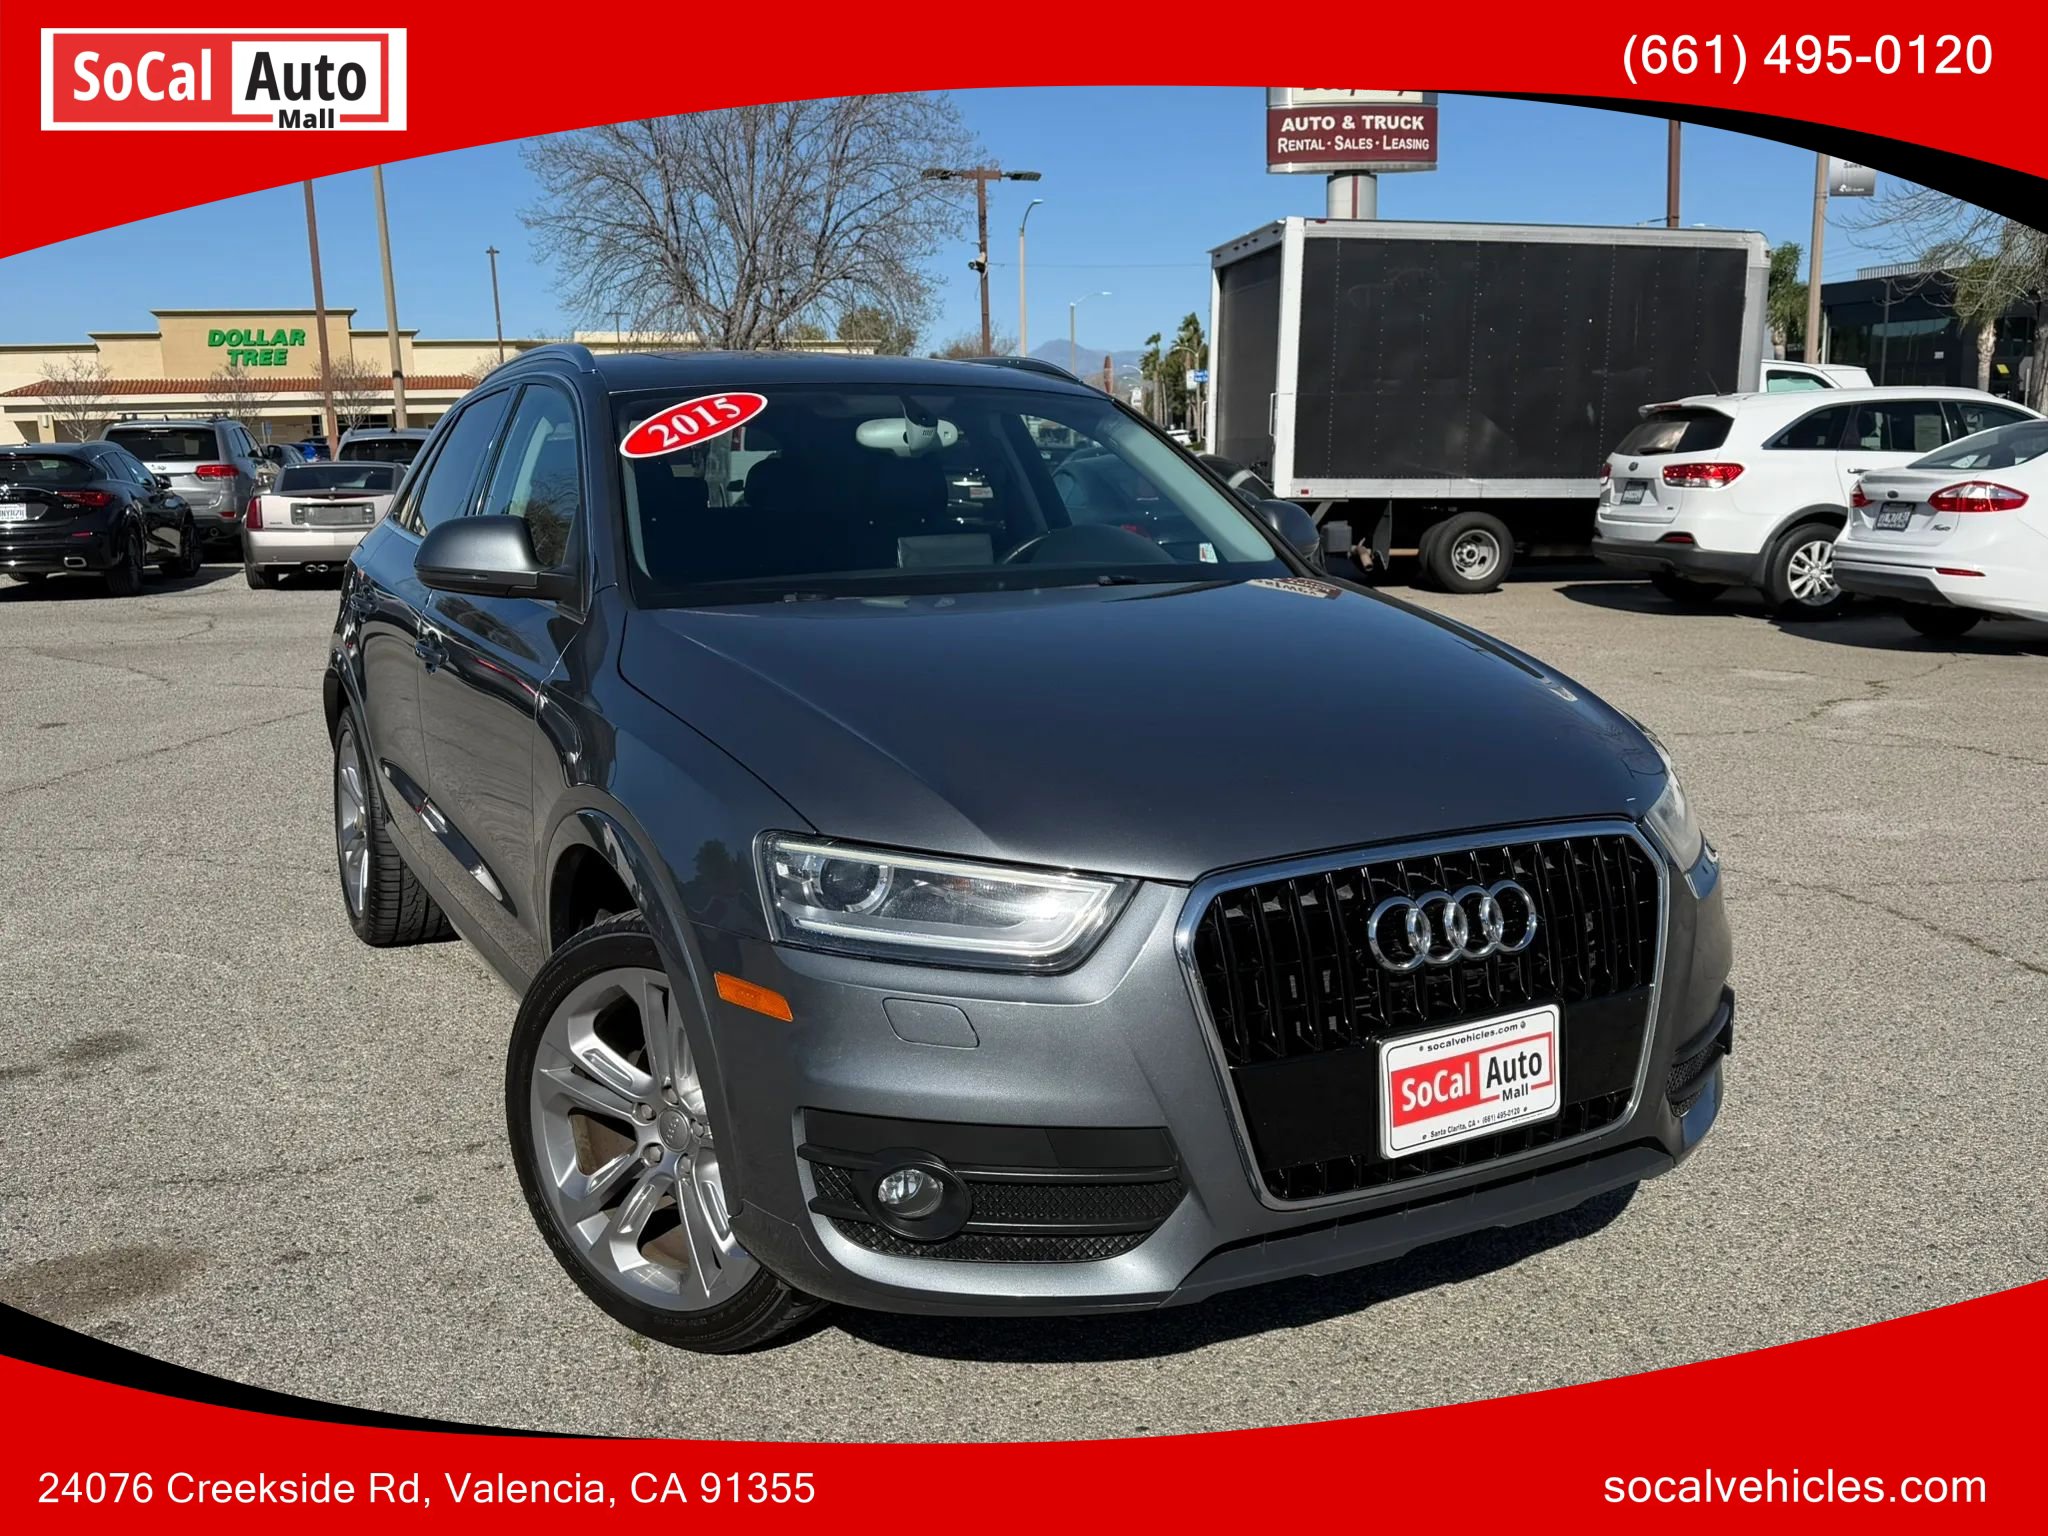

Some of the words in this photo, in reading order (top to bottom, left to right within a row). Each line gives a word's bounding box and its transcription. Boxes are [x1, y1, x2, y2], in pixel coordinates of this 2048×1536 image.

[1281, 116, 1335, 133] AUTO
[1341, 115, 1356, 130] &
[1361, 115, 1425, 131] TRUCK
[208, 328, 306, 347] DOLLAR
[227, 348, 288, 367] TREE
[648, 397, 741, 448] 2015
[1427, 1022, 1518, 1052] socalvehicles.com
[1401, 1061, 1472, 1112] SoCal
[1486, 1050, 1543, 1089] Auto
[1502, 1083, 1529, 1102] Mall
